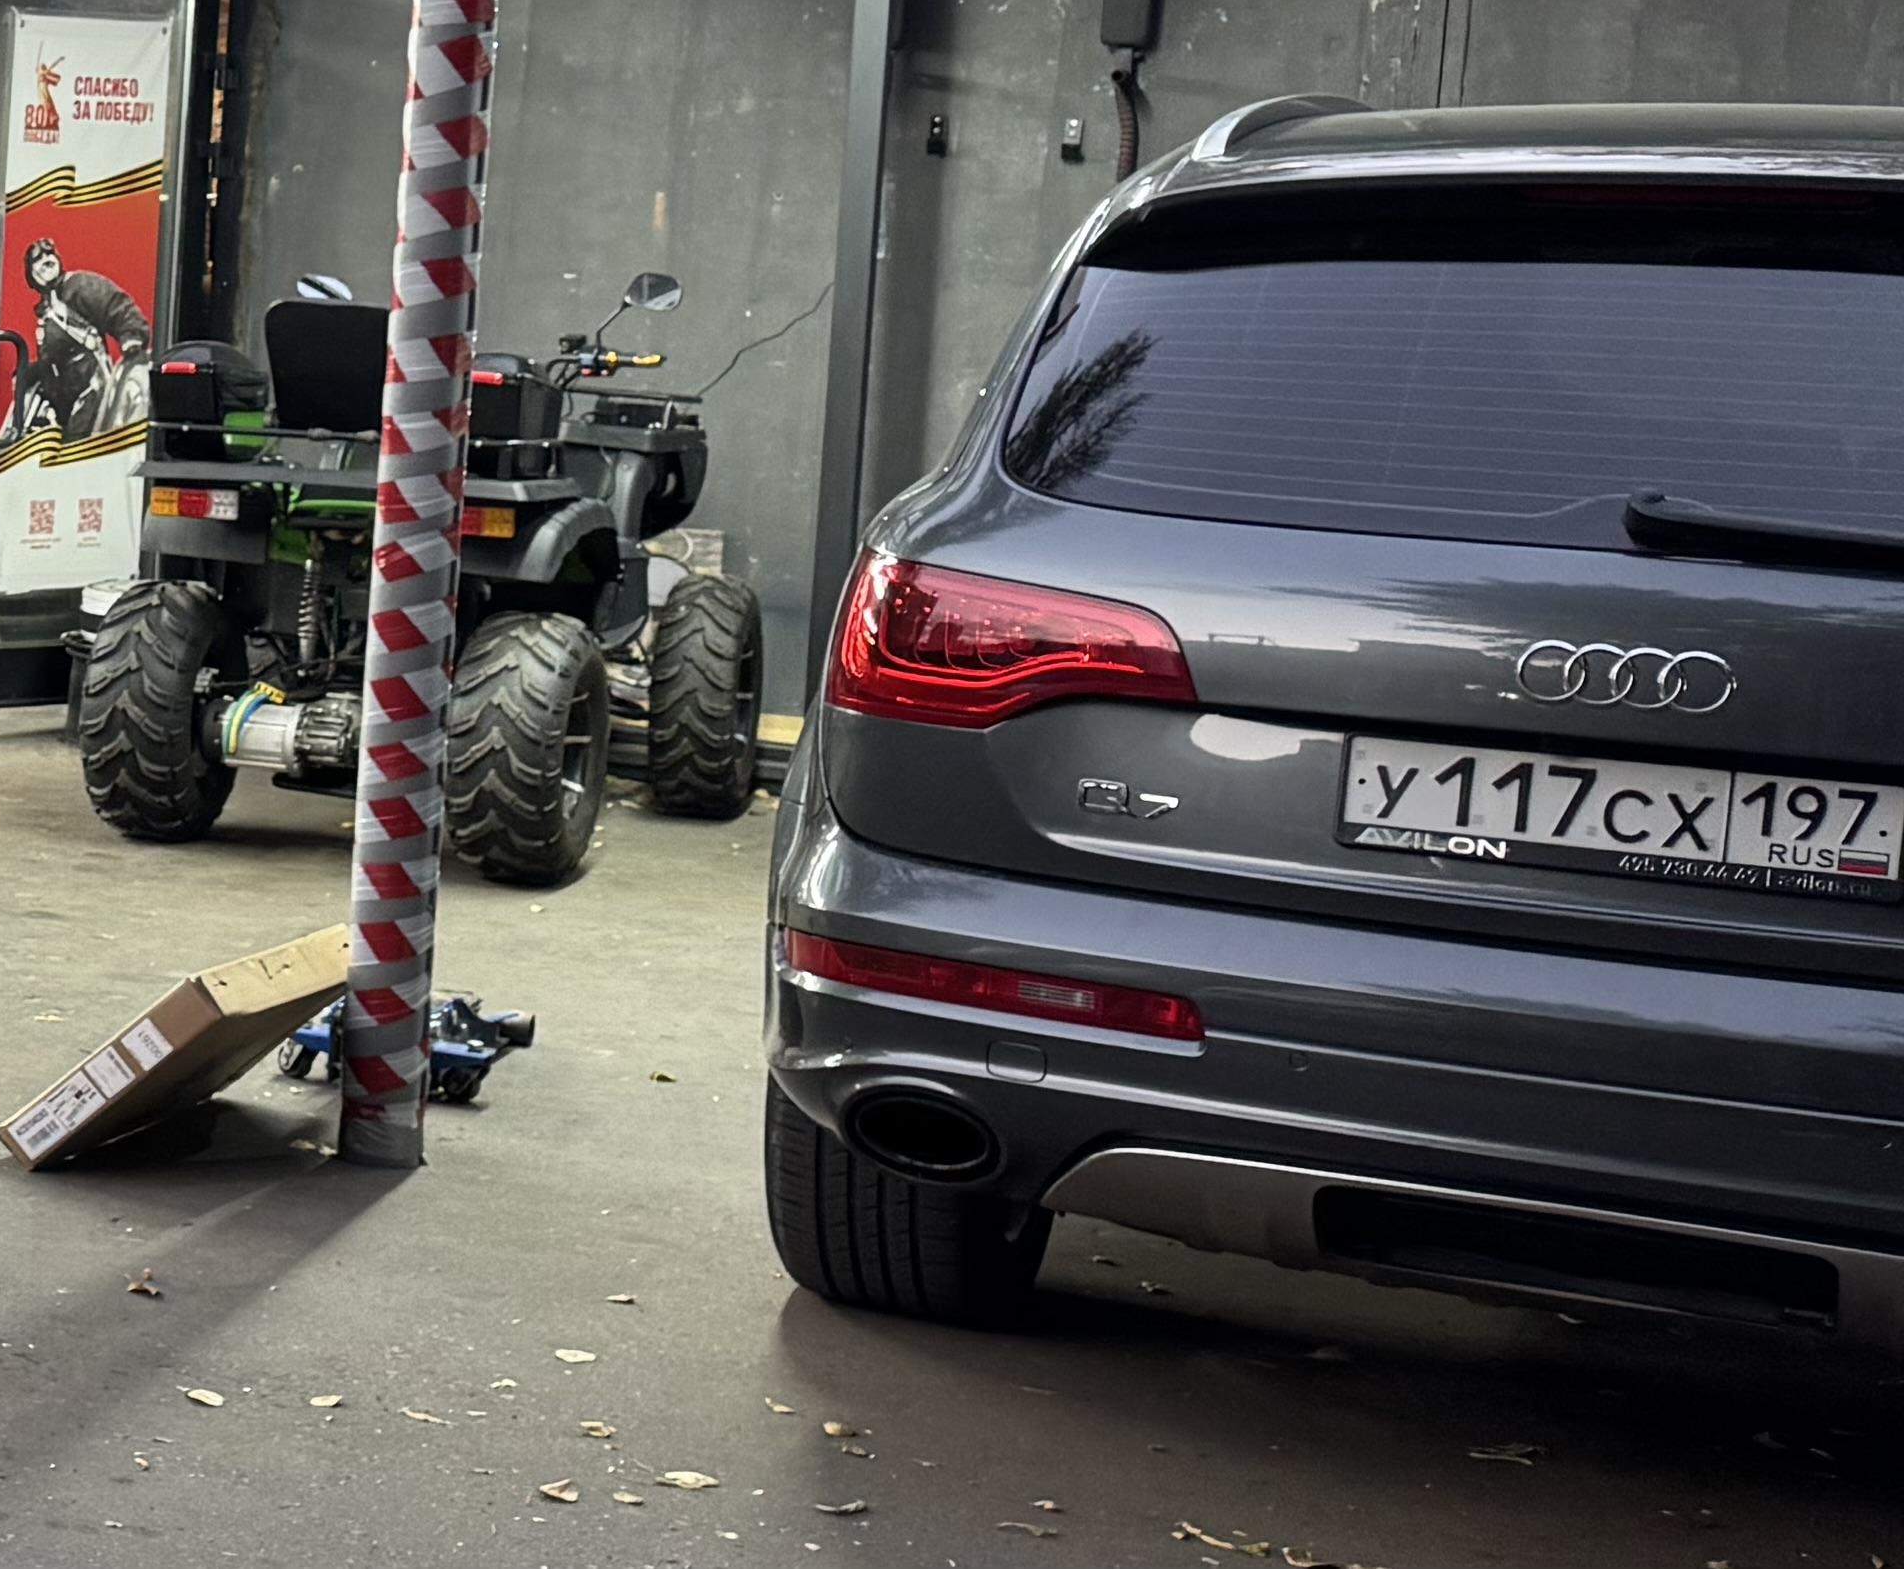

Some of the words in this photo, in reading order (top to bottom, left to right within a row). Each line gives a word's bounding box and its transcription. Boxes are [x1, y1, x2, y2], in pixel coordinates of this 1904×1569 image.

[74, 76, 139, 98] СПАСИБО
[72, 100, 91, 120] ЗА
[94, 102, 155, 126] ПОБЕДУ!
[1741, 781, 1880, 846] 197
[1354, 826, 1509, 860] AVILON
[1768, 842, 1835, 869] RUS
